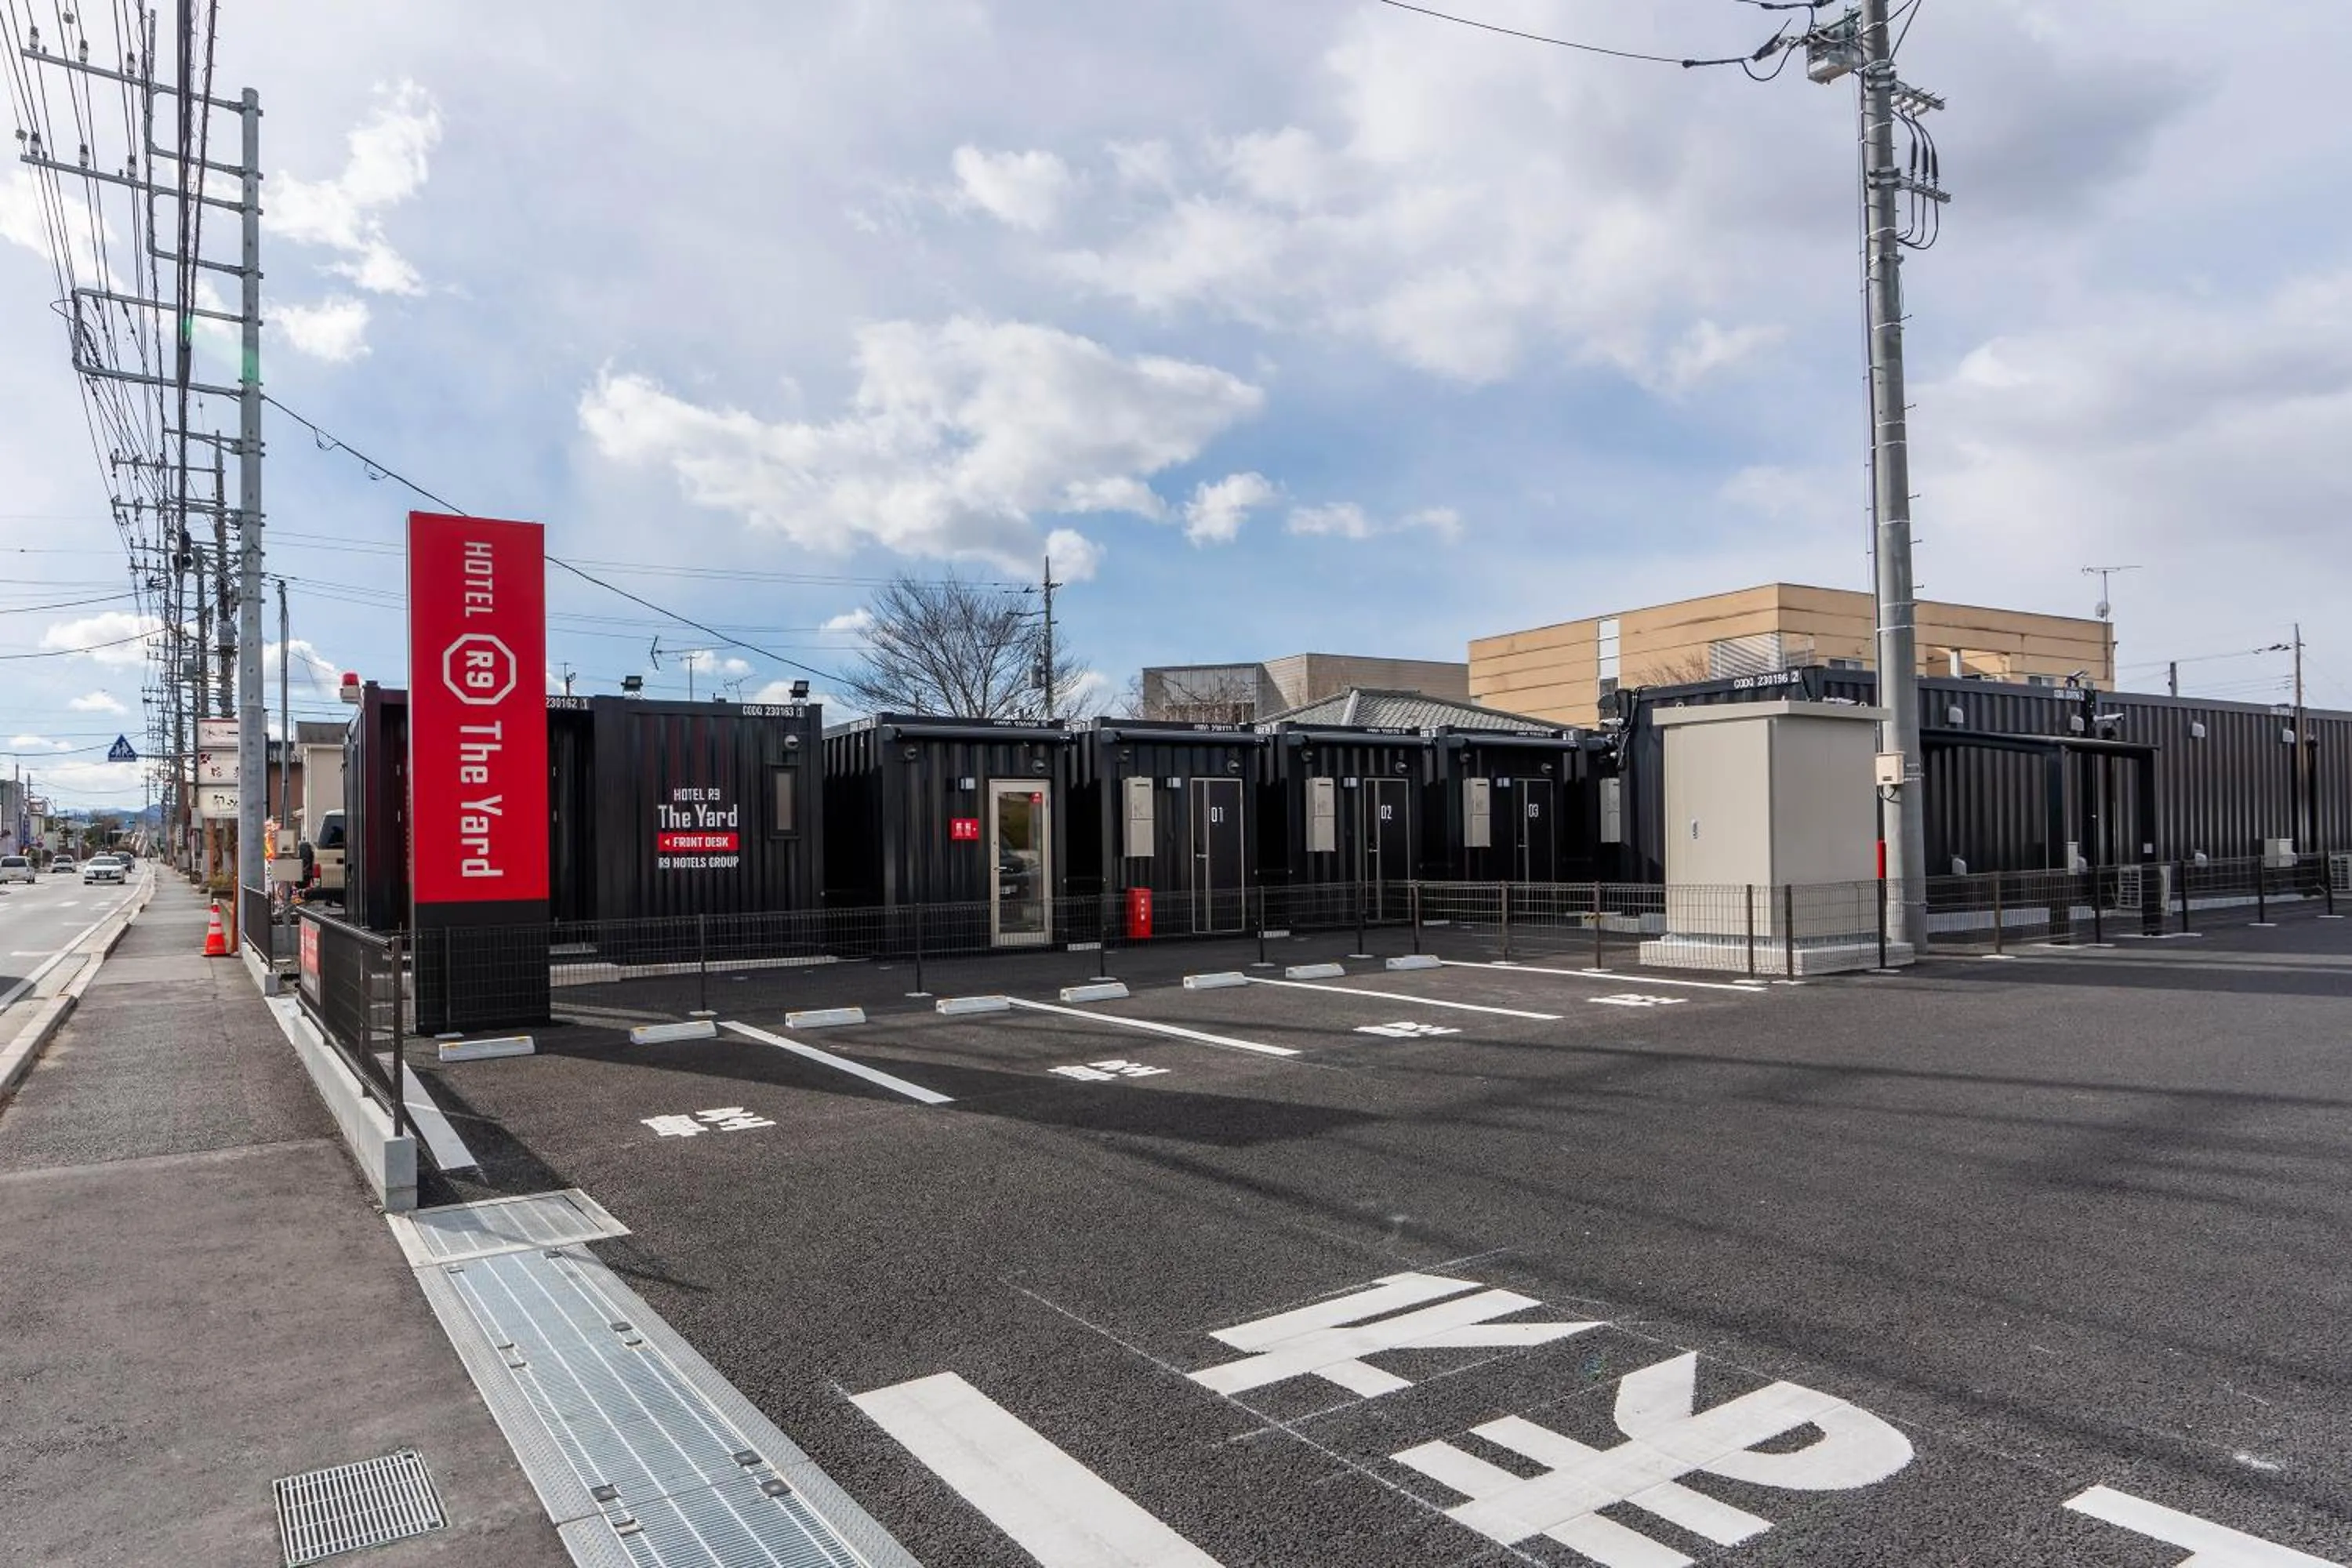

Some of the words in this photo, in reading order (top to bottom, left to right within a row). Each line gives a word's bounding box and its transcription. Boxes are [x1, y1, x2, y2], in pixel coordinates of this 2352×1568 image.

[464, 541, 493, 618] HOTEL
[466, 650, 494, 688] R9
[459, 720, 502, 783] The
[673, 788, 705, 800] HOTEL
[708, 788, 720, 800] R9
[657, 804, 691, 829] The
[695, 804, 739, 827] Yard
[1211, 807, 1224, 822] 01
[1381, 804, 1392, 819] 02
[1528, 804, 1538, 817] 03
[460, 794, 504, 877] Yard
[673, 837, 703, 848] FRONT
[705, 837, 728, 848] DESK
[658, 857, 670, 869] R9
[673, 857, 706, 869] HOTELS
[708, 855, 739, 869] GROUP
[1185, 1271, 2352, 1568] まれ
